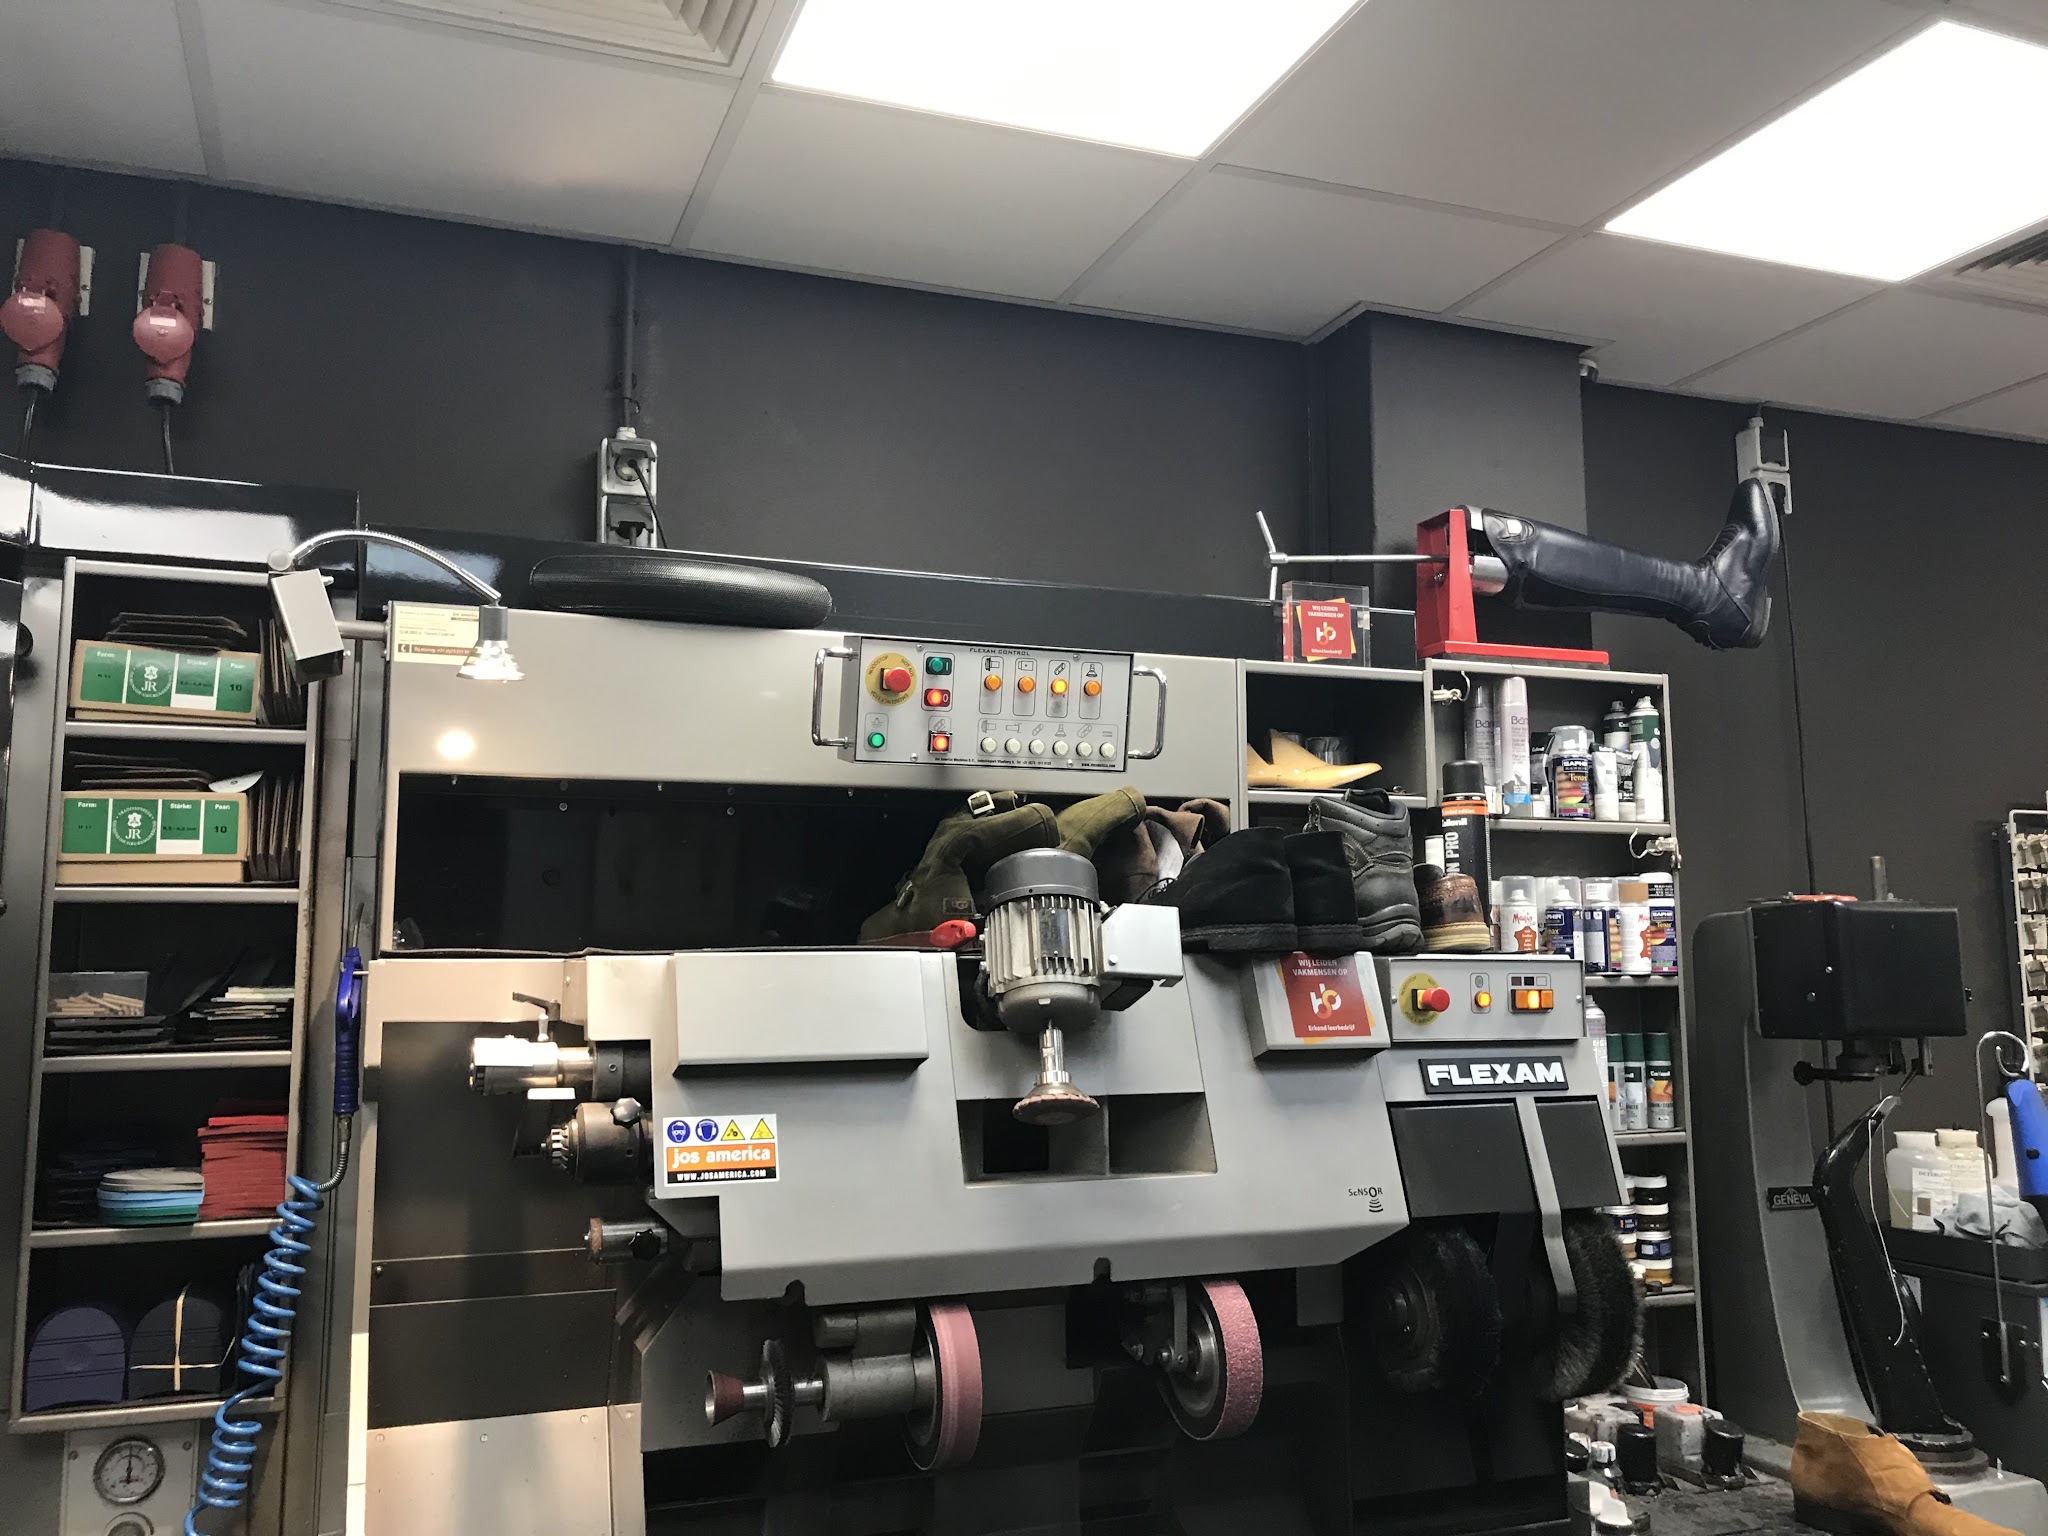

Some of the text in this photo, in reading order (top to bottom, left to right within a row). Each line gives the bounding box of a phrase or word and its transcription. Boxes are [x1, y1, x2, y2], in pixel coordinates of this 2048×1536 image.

[141, 680, 157, 692] JR
[229, 683, 243, 692] 10
[77, 801, 98, 809] Form:
[125, 828, 142, 840] JR
[213, 825, 228, 834] 10
[1444, 831, 1460, 859] PRO
[1298, 959, 1312, 968] WIJ
[1292, 968, 1337, 976] VAKMENSEN
[1327, 1024, 1355, 1032] leerbedrijf
[1427, 1061, 1565, 1087] FLEXAM
[672, 1145, 771, 1169] jos america
[677, 1169, 767, 1182] WWW.JOSAMERICA.COM
[1773, 1193, 1812, 1206] GENEVA
